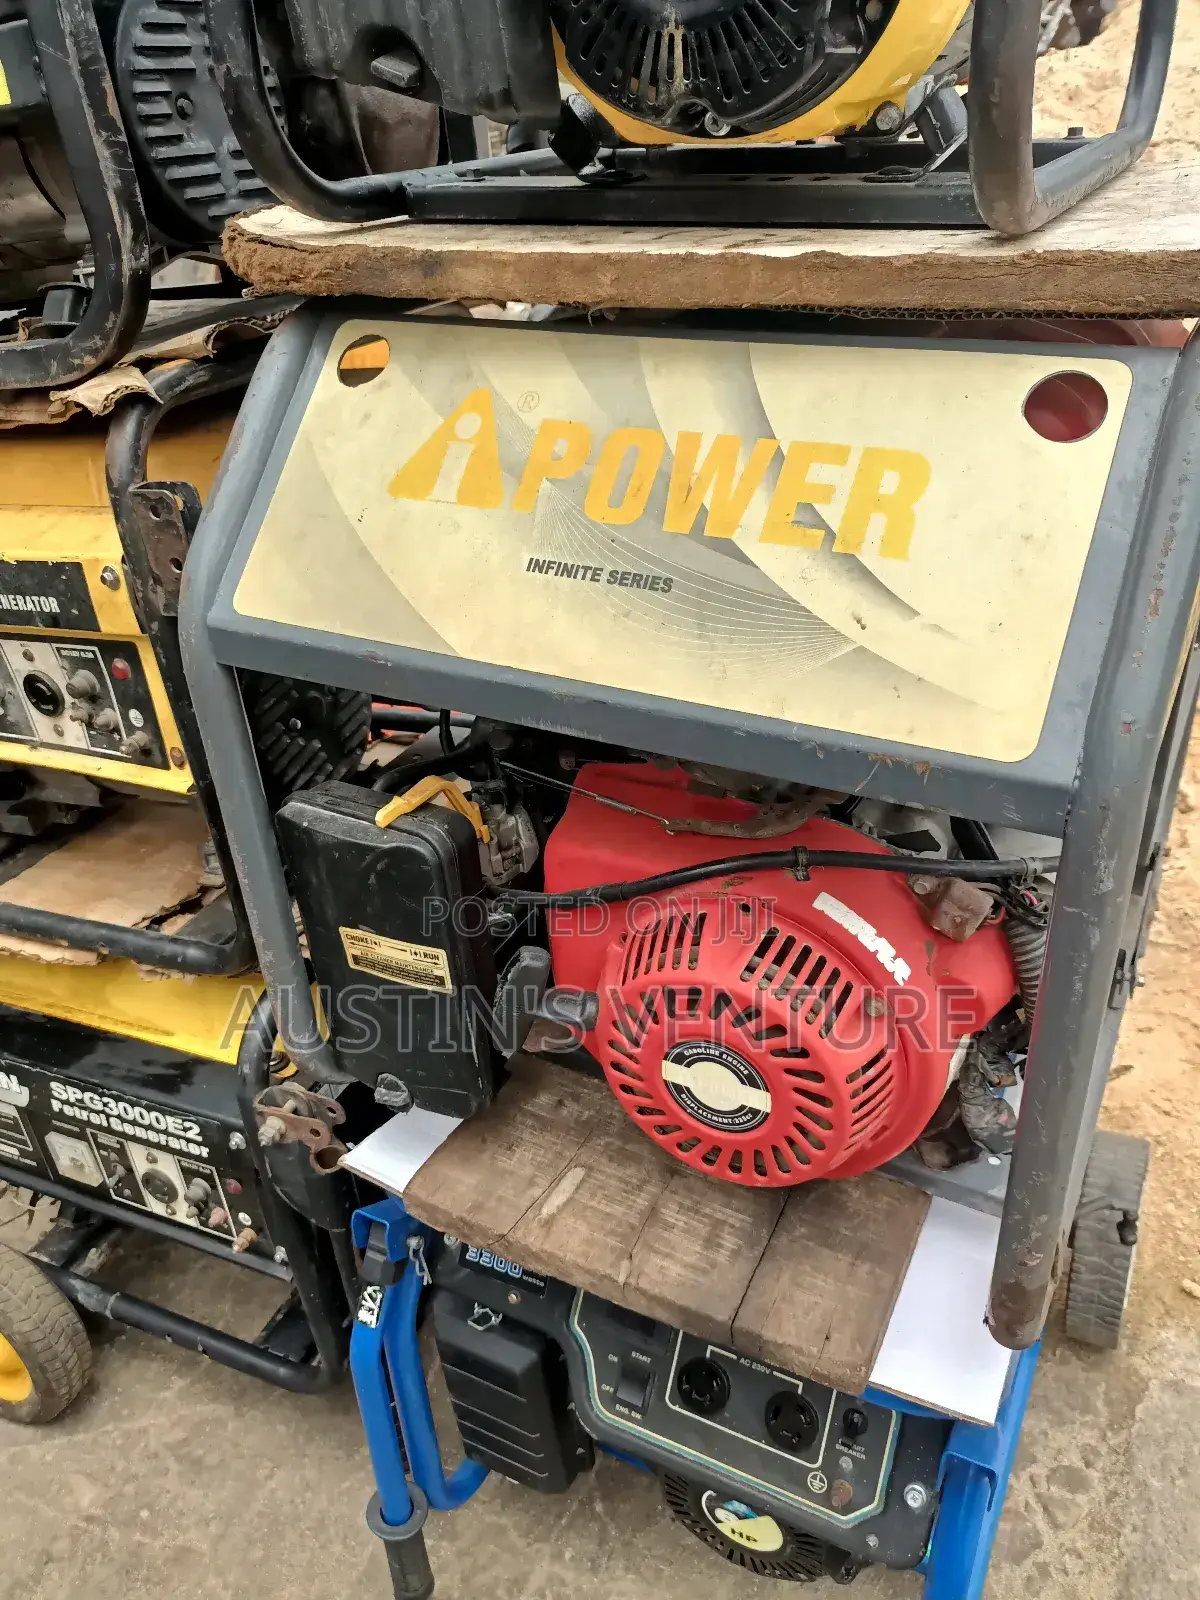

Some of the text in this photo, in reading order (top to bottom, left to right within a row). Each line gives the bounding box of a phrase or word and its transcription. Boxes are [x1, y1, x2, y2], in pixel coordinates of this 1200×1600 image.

[525, 557, 674, 594] INFINITE SERIES
[345, 933, 440, 961] CHOKE RUN
[395, 959, 434, 974] MAINTENANCE
[683, 1047, 750, 1075] GASOLINE ENGINE
[50, 1081, 203, 1142] SPG3000E2
[50, 1098, 109, 1127] Petrol
[109, 1116, 210, 1159] Generator
[607, 1353, 619, 1363] ON
[631, 1351, 651, 1364] START
[739, 1357, 771, 1375] AC 230V
[601, 1383, 614, 1393] OFF
[835, 1443, 866, 1460] BREAKER
[730, 1527, 758, 1543] HP
